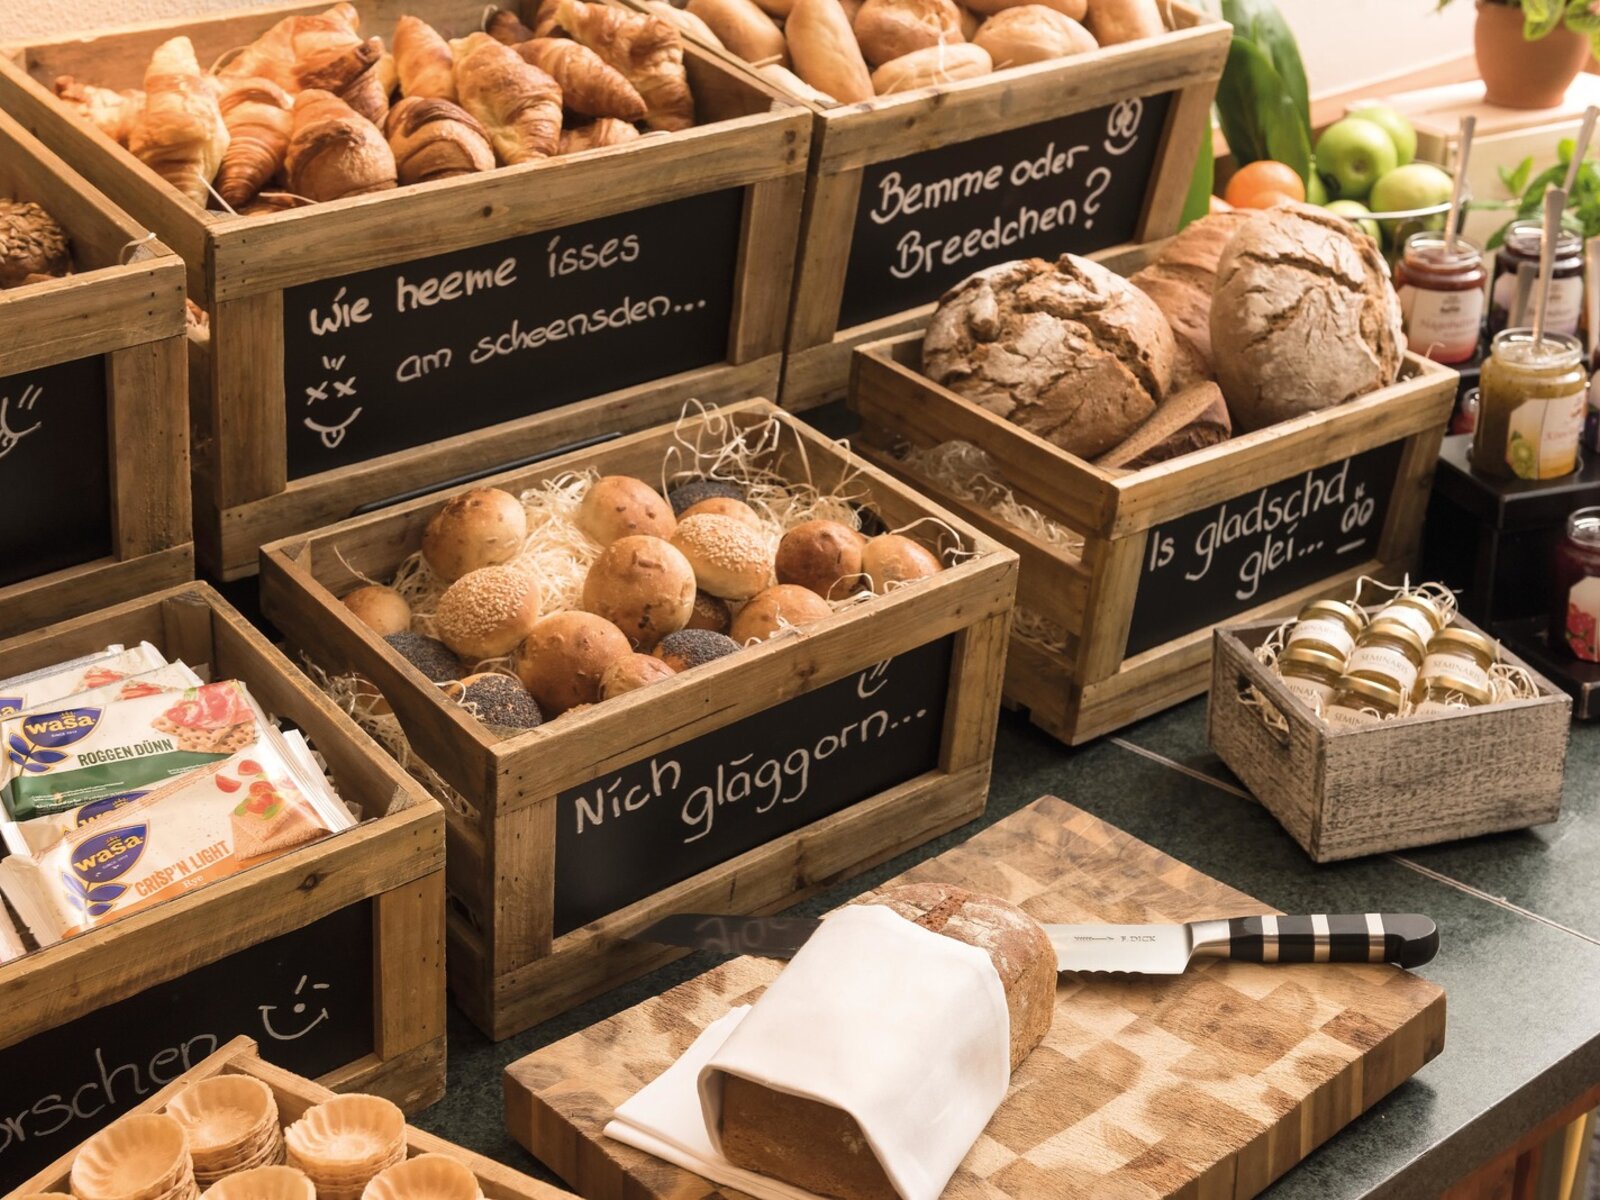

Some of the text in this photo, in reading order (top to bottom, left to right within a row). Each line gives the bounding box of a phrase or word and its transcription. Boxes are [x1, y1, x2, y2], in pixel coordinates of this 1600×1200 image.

[870, 142, 1090, 225] Bemme oder
[396, 257, 517, 313] heeme
[547, 234, 640, 279] isses
[396, 347, 453, 383] am
[1360, 654, 1409, 674] SEMINARIS
[25, 714, 95, 736] wasa
[77, 738, 174, 767] ROGGEN DÜNN
[574, 758, 682, 835] Nich
[74, 835, 143, 873] wasa
[134, 860, 191, 897] CRISP'N
[189, 840, 231, 869] LIGHT
